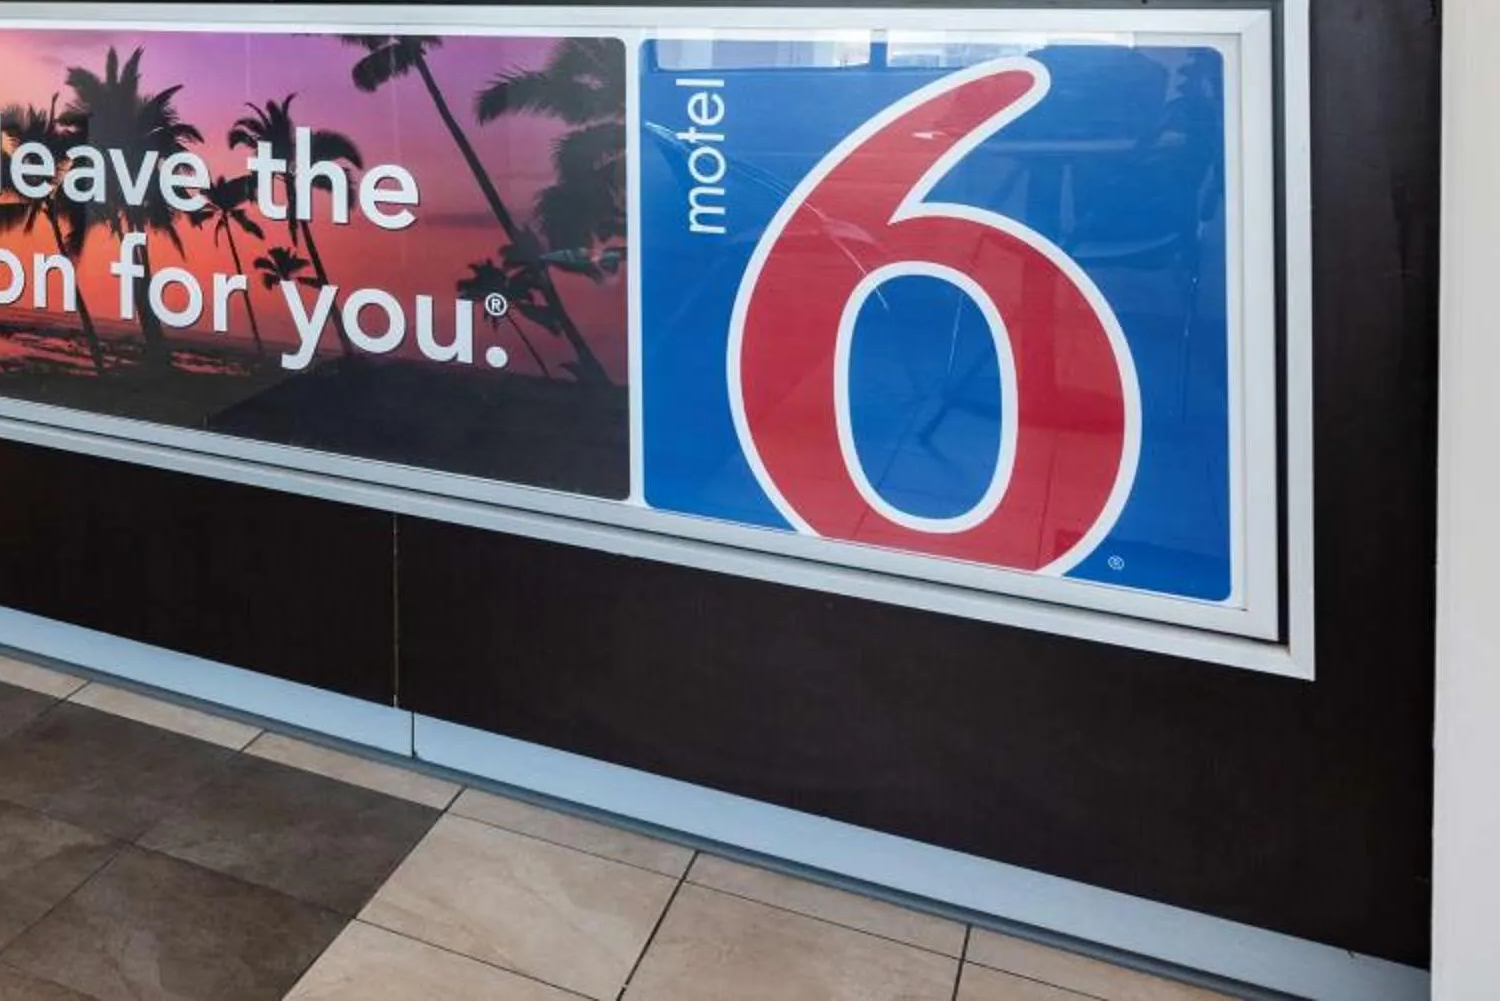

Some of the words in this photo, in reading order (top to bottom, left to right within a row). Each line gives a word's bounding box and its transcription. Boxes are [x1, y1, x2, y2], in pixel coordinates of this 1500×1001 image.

[247, 127, 420, 229] the
[110, 231, 248, 332] for
[676, 79, 726, 235] motel
[726, 55, 1143, 579] 6
